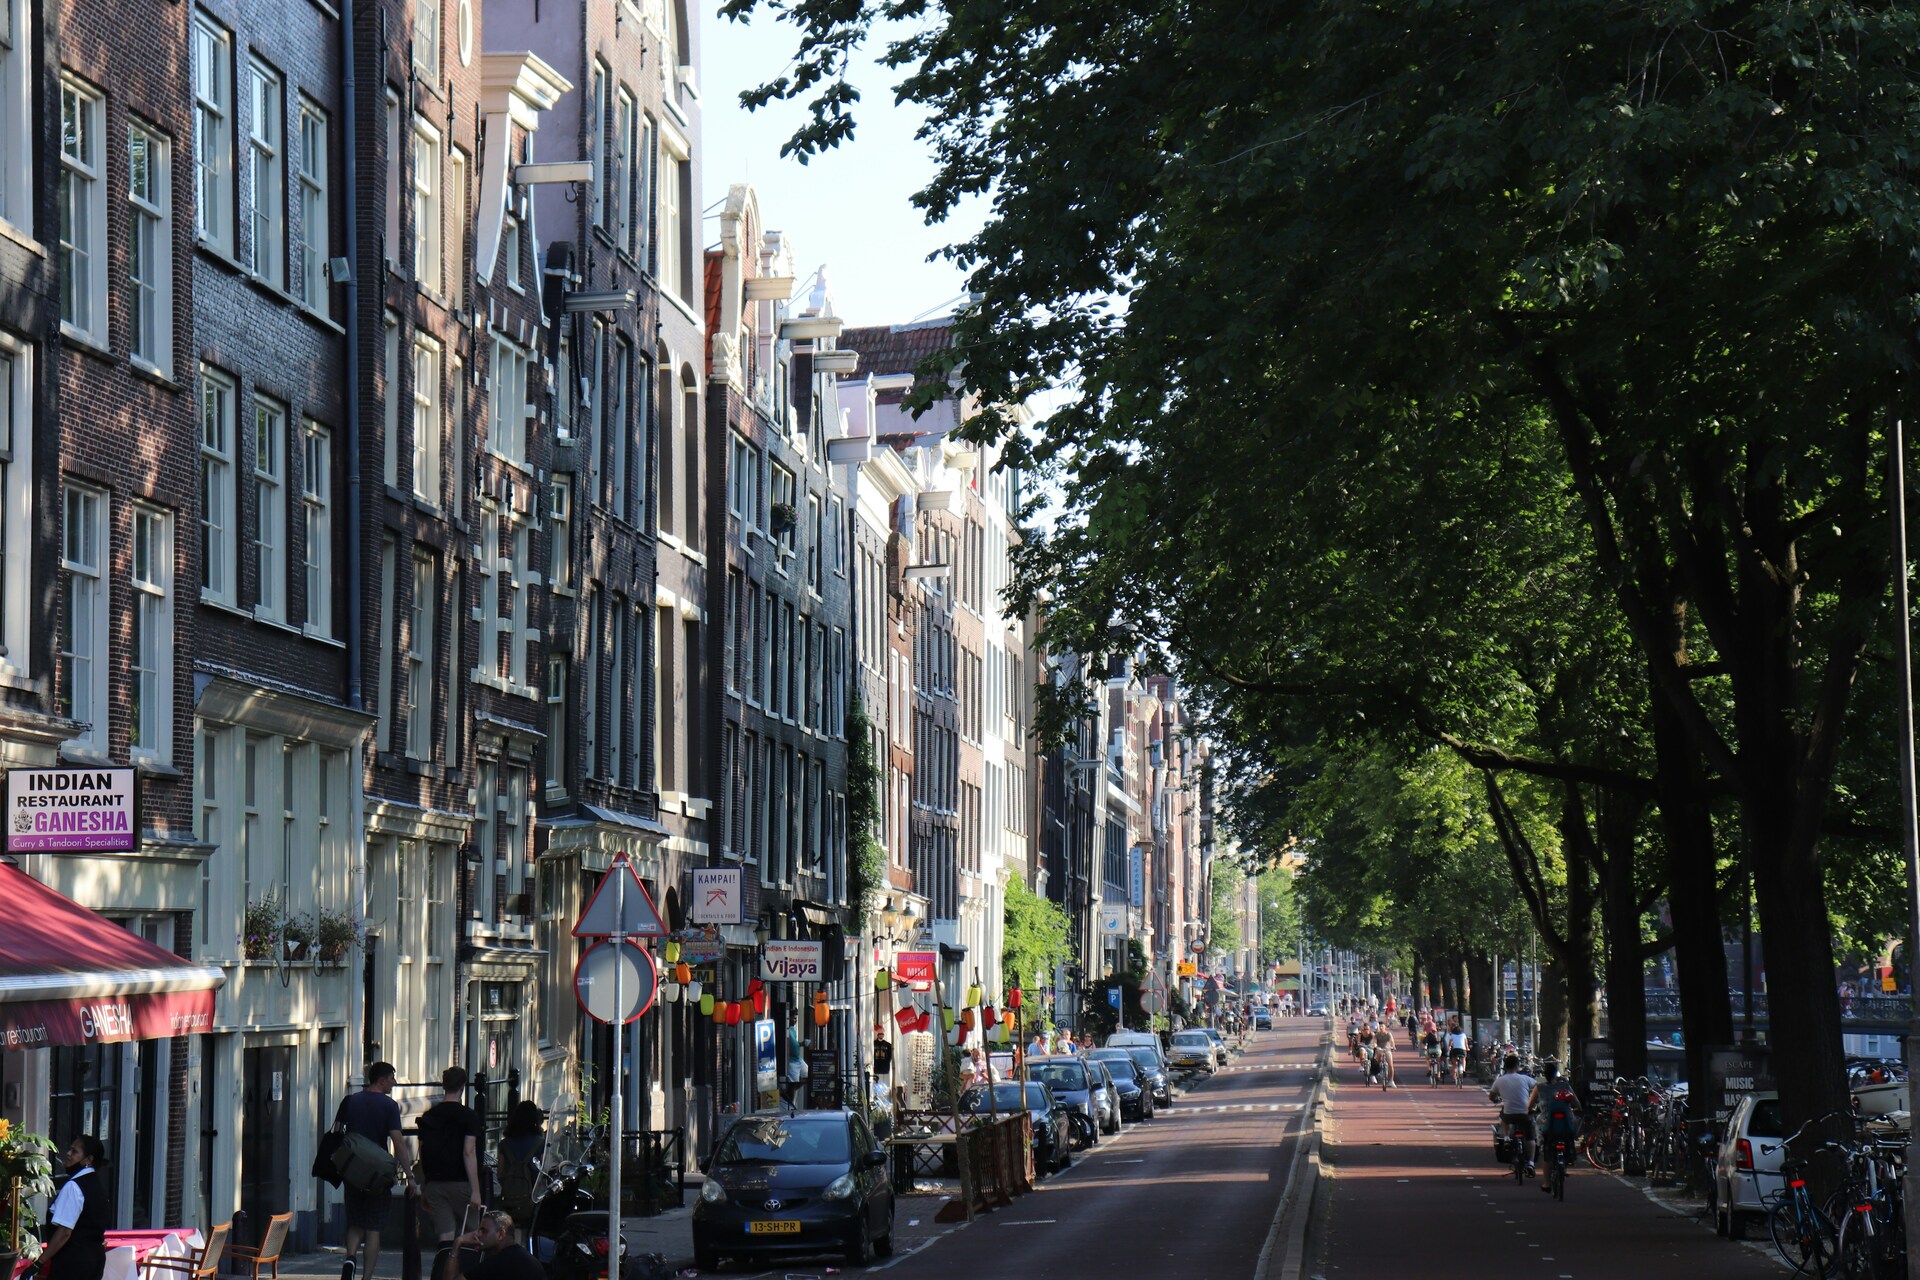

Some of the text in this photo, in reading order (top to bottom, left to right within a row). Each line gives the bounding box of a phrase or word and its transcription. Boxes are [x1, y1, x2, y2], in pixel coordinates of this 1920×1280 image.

[29, 773, 112, 791] INDIAN
[17, 794, 124, 807] RESTAURANT
[34, 811, 128, 832] GANESHA
[12, 836, 129, 848] Curry & Tandoori Specialities
[698, 874, 736, 884] KAMPAI!
[766, 956, 817, 978] Vijaya
[906, 967, 927, 977] MINI
[79, 1003, 134, 1038] GANESHA
[6, 1022, 48, 1045] restaurant
[761, 1026, 771, 1051] P
[1725, 1077, 1754, 1089] MUSIC
[754, 1222, 796, 1232] 13-SH-PR
